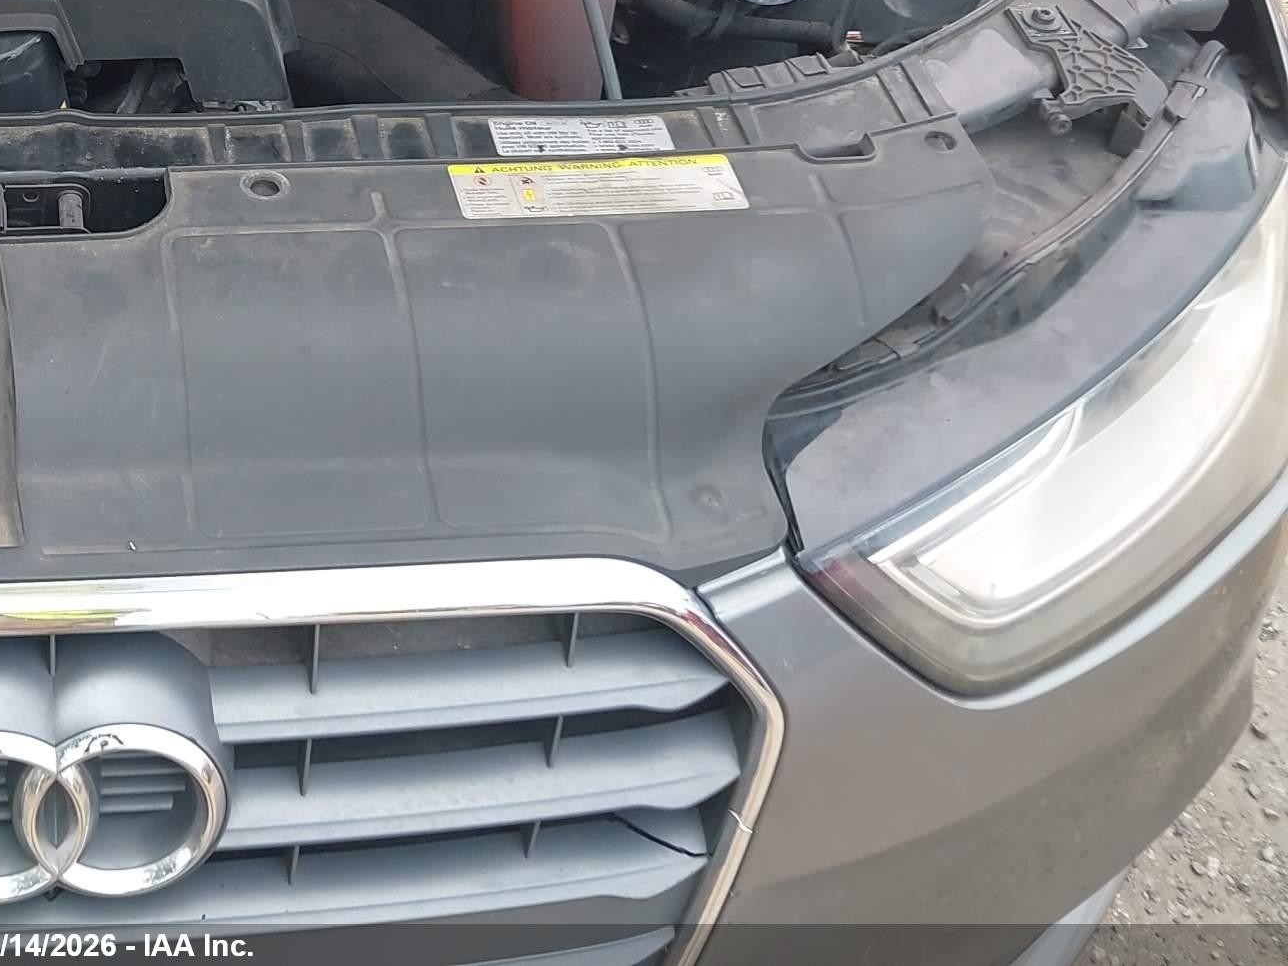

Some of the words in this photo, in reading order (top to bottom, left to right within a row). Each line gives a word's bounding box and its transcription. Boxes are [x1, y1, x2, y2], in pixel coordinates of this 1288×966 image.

[491, 164, 553, 173] ACHTUNG
[558, 160, 624, 171] WARNING
[628, 156, 698, 168] ATTENTION
